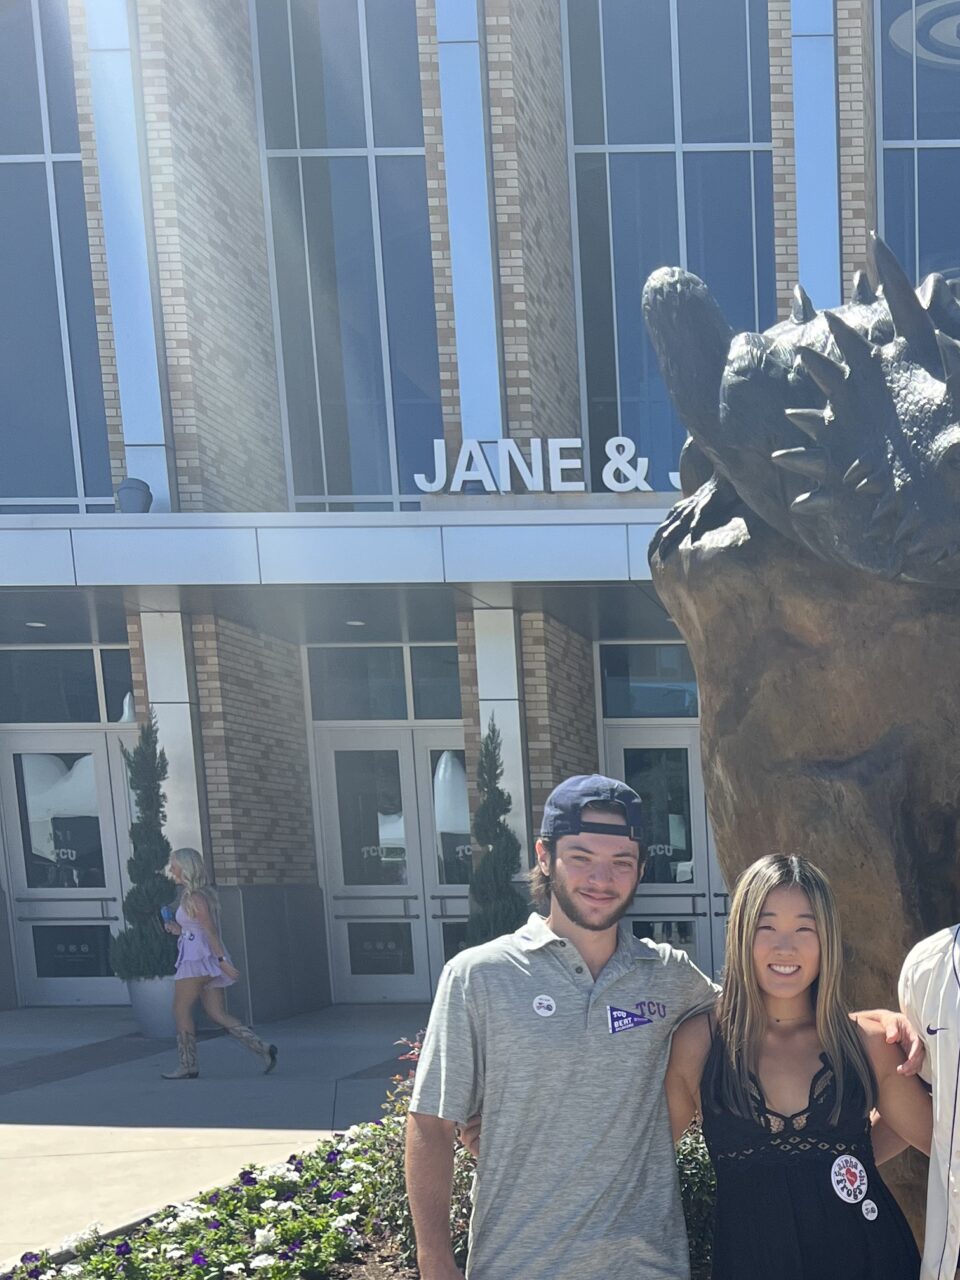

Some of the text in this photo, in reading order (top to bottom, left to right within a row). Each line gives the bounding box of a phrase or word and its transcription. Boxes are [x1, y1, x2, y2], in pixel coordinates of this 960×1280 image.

[414, 438, 586, 492] JANE
[602, 436, 650, 492] &
[361, 846, 386, 859] TCU
[456, 845, 472, 857] TC
[648, 844, 673, 857] TCU
[612, 1010, 627, 1018] TCU
[635, 1001, 666, 1018] TCU
[613, 1017, 632, 1028] BEAT
